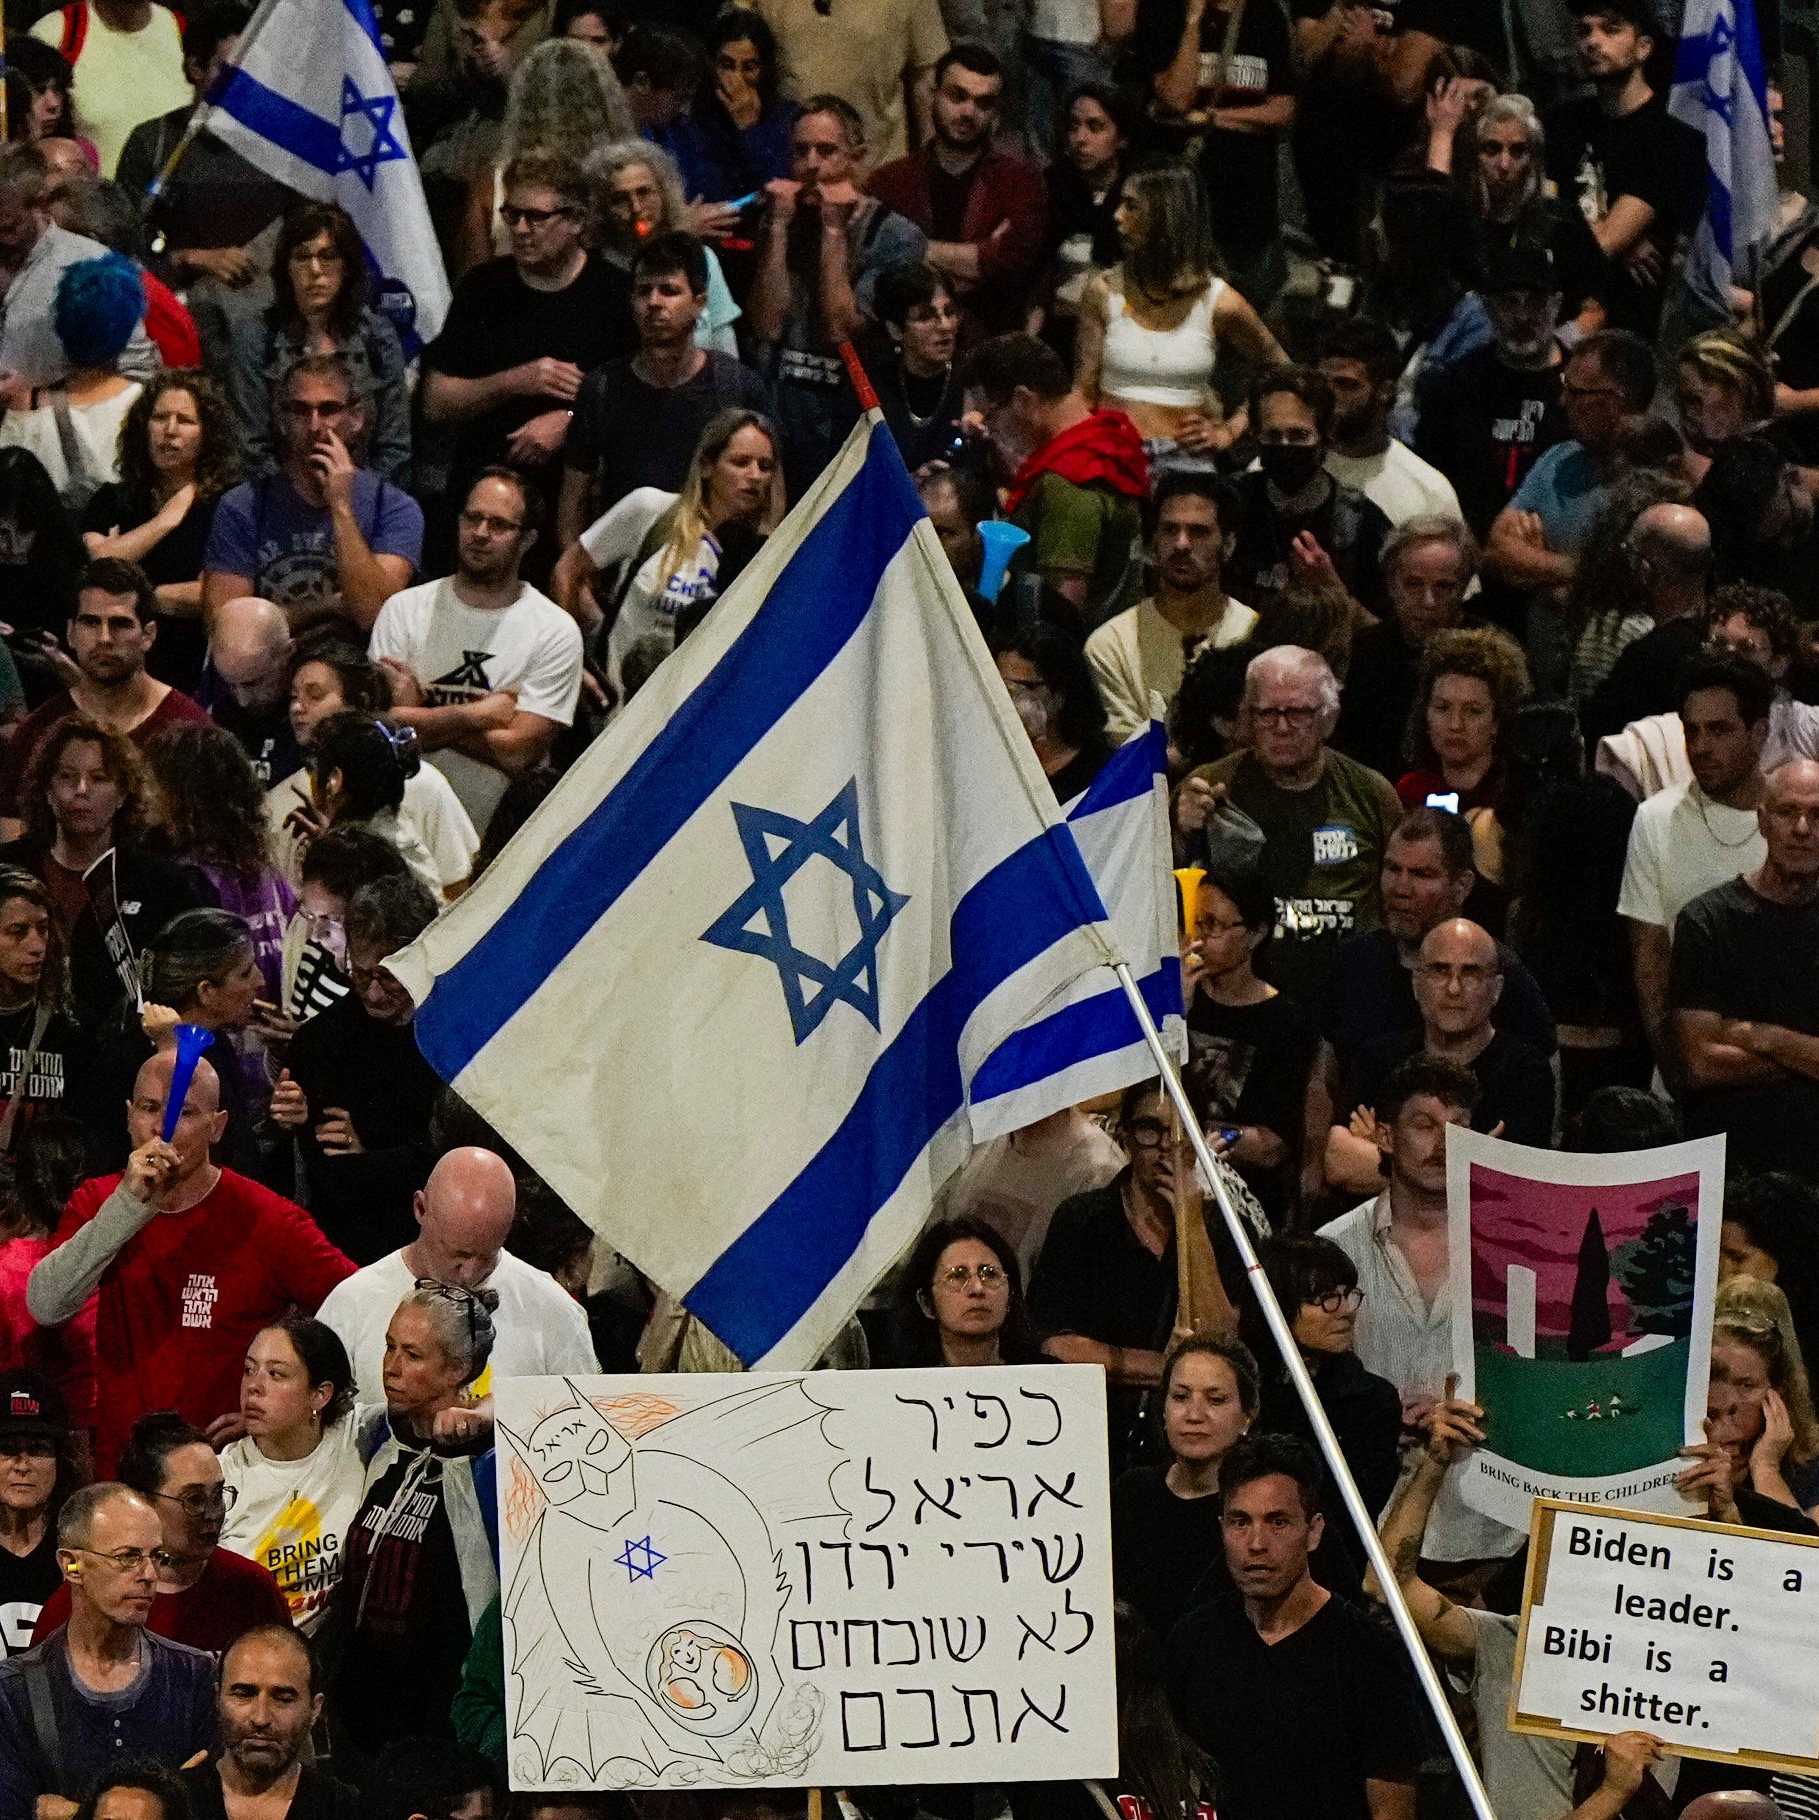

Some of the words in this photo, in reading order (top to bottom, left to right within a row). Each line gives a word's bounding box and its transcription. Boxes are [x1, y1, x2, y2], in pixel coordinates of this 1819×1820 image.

[10, 1047, 64, 1077] מחזיים
[181, 1287, 219, 1302] הראש
[187, 1273, 216, 1288] אתה
[182, 1313, 213, 1328] אשם
[183, 1300, 213, 1315] אתה
[894, 1386, 1064, 1452] כפיר
[862, 1456, 1085, 1532] אריאל
[1479, 1461, 1521, 1490] BRING
[1523, 1483, 1561, 1501] BACK
[1564, 1489, 1601, 1504] THE
[1604, 1471, 1677, 1500] CHILDREN
[267, 1532, 339, 1568] BRING
[271, 1553, 340, 1587] THEM
[794, 1540, 910, 1604] ירדן
[940, 1531, 1085, 1586] שירי
[1568, 1524, 1673, 1573] Biden
[1708, 1548, 1735, 1583] is
[1782, 1564, 1804, 1593] a
[1016, 1587, 1095, 1662] לא
[1614, 1584, 1741, 1632] leader.
[788, 1613, 988, 1672] שוכחים
[1542, 1625, 1613, 1667] Bibi
[1644, 1641, 1673, 1675] is
[1707, 1657, 1730, 1684] a
[839, 1682, 1070, 1753] אתכם
[1579, 1682, 1710, 1731] shitter.
